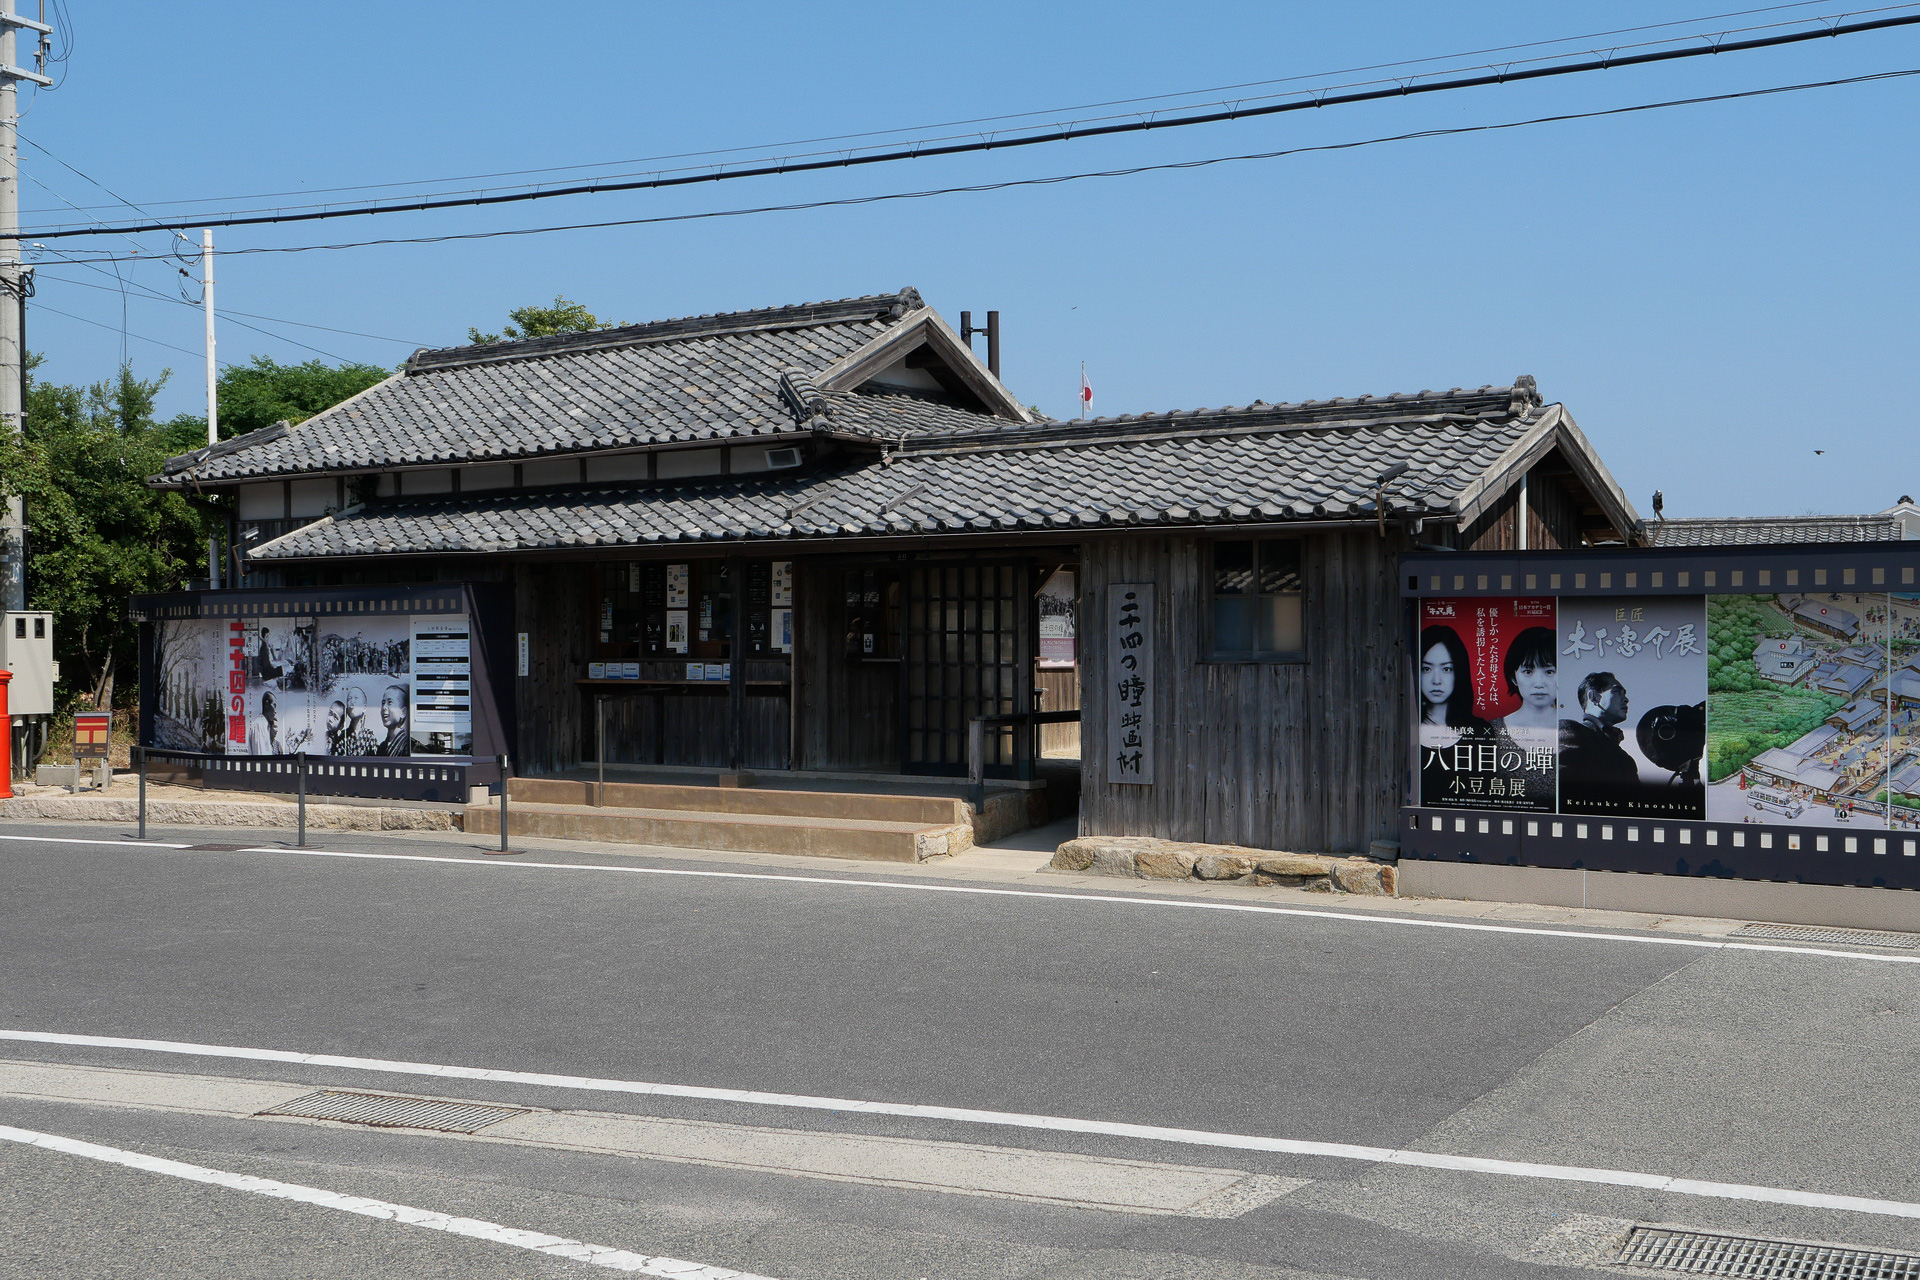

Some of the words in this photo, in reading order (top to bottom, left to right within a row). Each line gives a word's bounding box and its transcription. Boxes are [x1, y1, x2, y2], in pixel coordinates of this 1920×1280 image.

[720, 565, 728, 578] 2
[1615, 608, 1645, 622] 巨匠
[1489, 608, 1499, 706] 優しかったお母さんは、
[229, 622, 246, 744] 二十四の瞳
[1117, 592, 1146, 775] 二十四の瞳映画村
[1449, 775, 1526, 797] 小豆島展
[1567, 799, 1619, 808] Keisuke
[1628, 801, 1697, 811] Kinoshita
